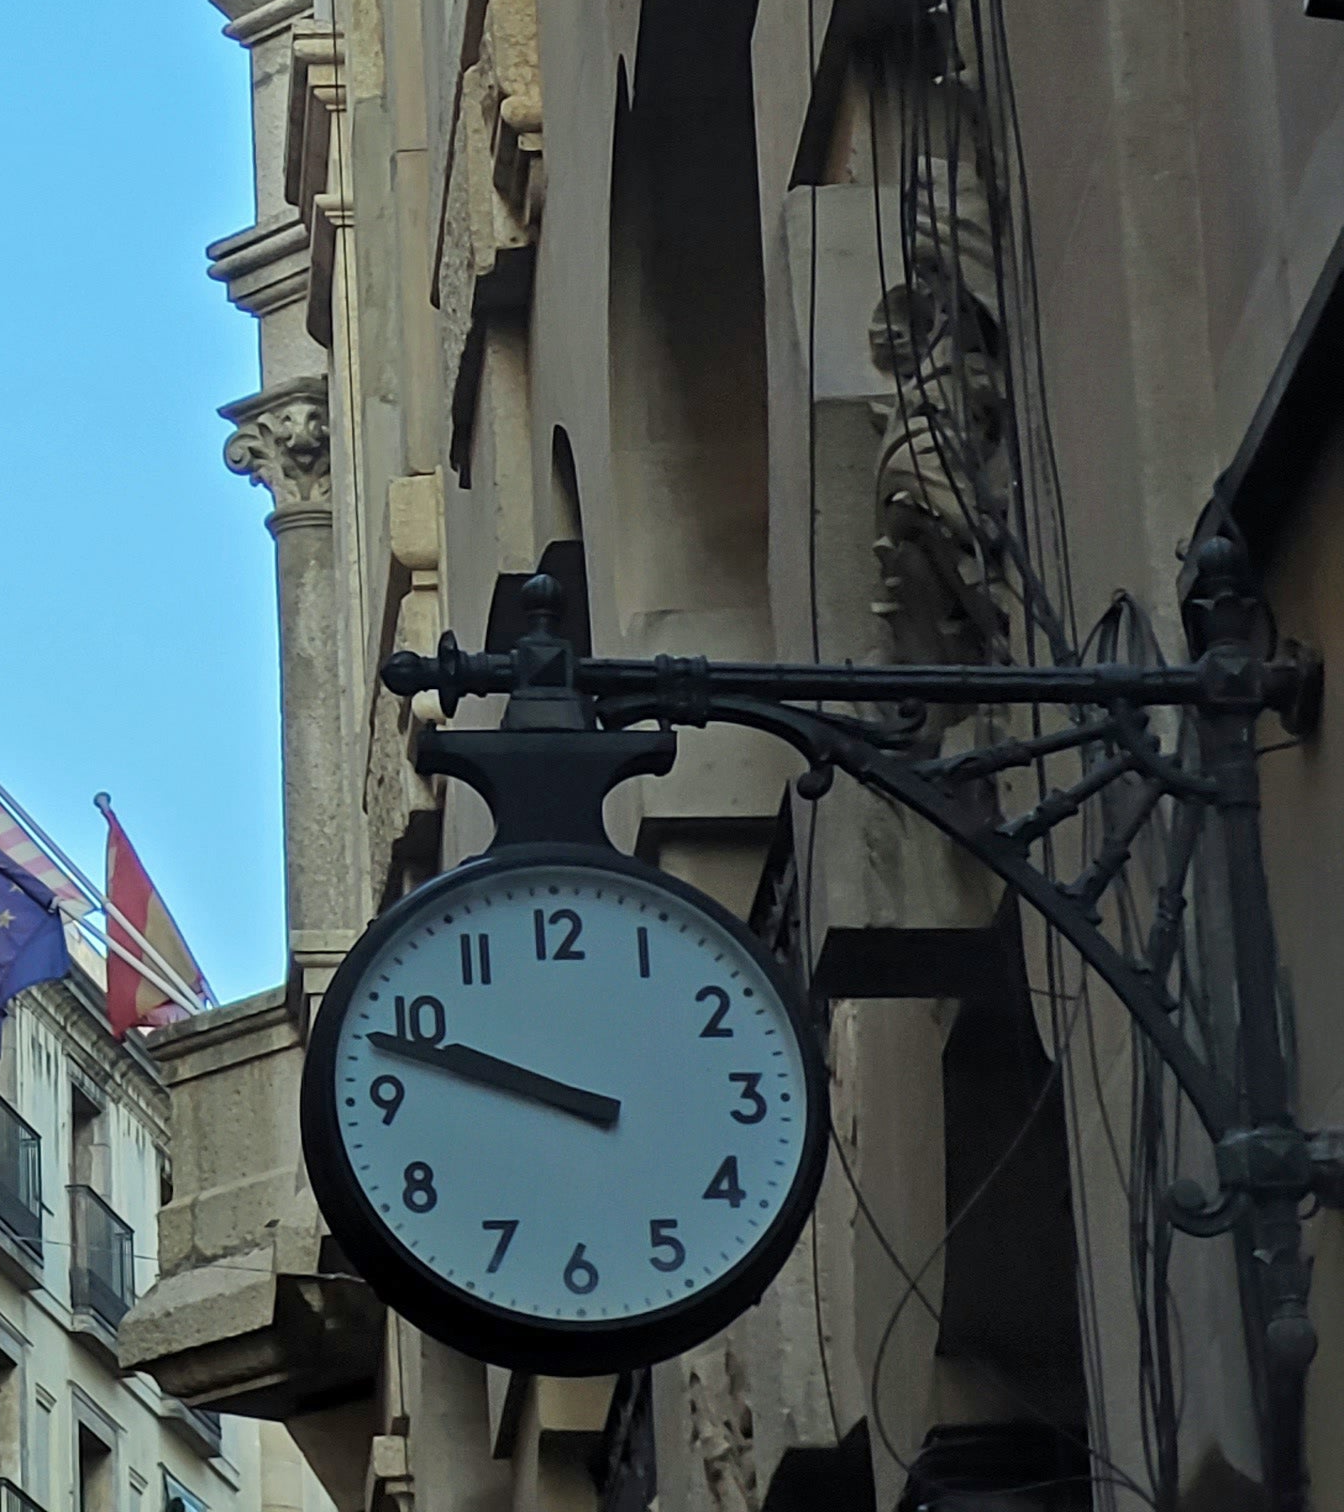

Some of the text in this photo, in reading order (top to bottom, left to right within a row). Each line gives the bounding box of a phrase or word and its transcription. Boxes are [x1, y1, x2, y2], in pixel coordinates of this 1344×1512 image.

[460, 933, 492, 986] 11
[533, 908, 586, 961] 12
[636, 926, 651, 978] 1
[394, 995, 447, 1047] 10
[694, 985, 734, 1038] 2
[369, 1074, 405, 1126] 9
[728, 1072, 768, 1125] 3
[402, 1160, 438, 1214] 8
[701, 1155, 747, 1208] 4
[481, 1219, 520, 1273] 7
[562, 1242, 599, 1295] 6
[649, 1218, 686, 1273] 5
